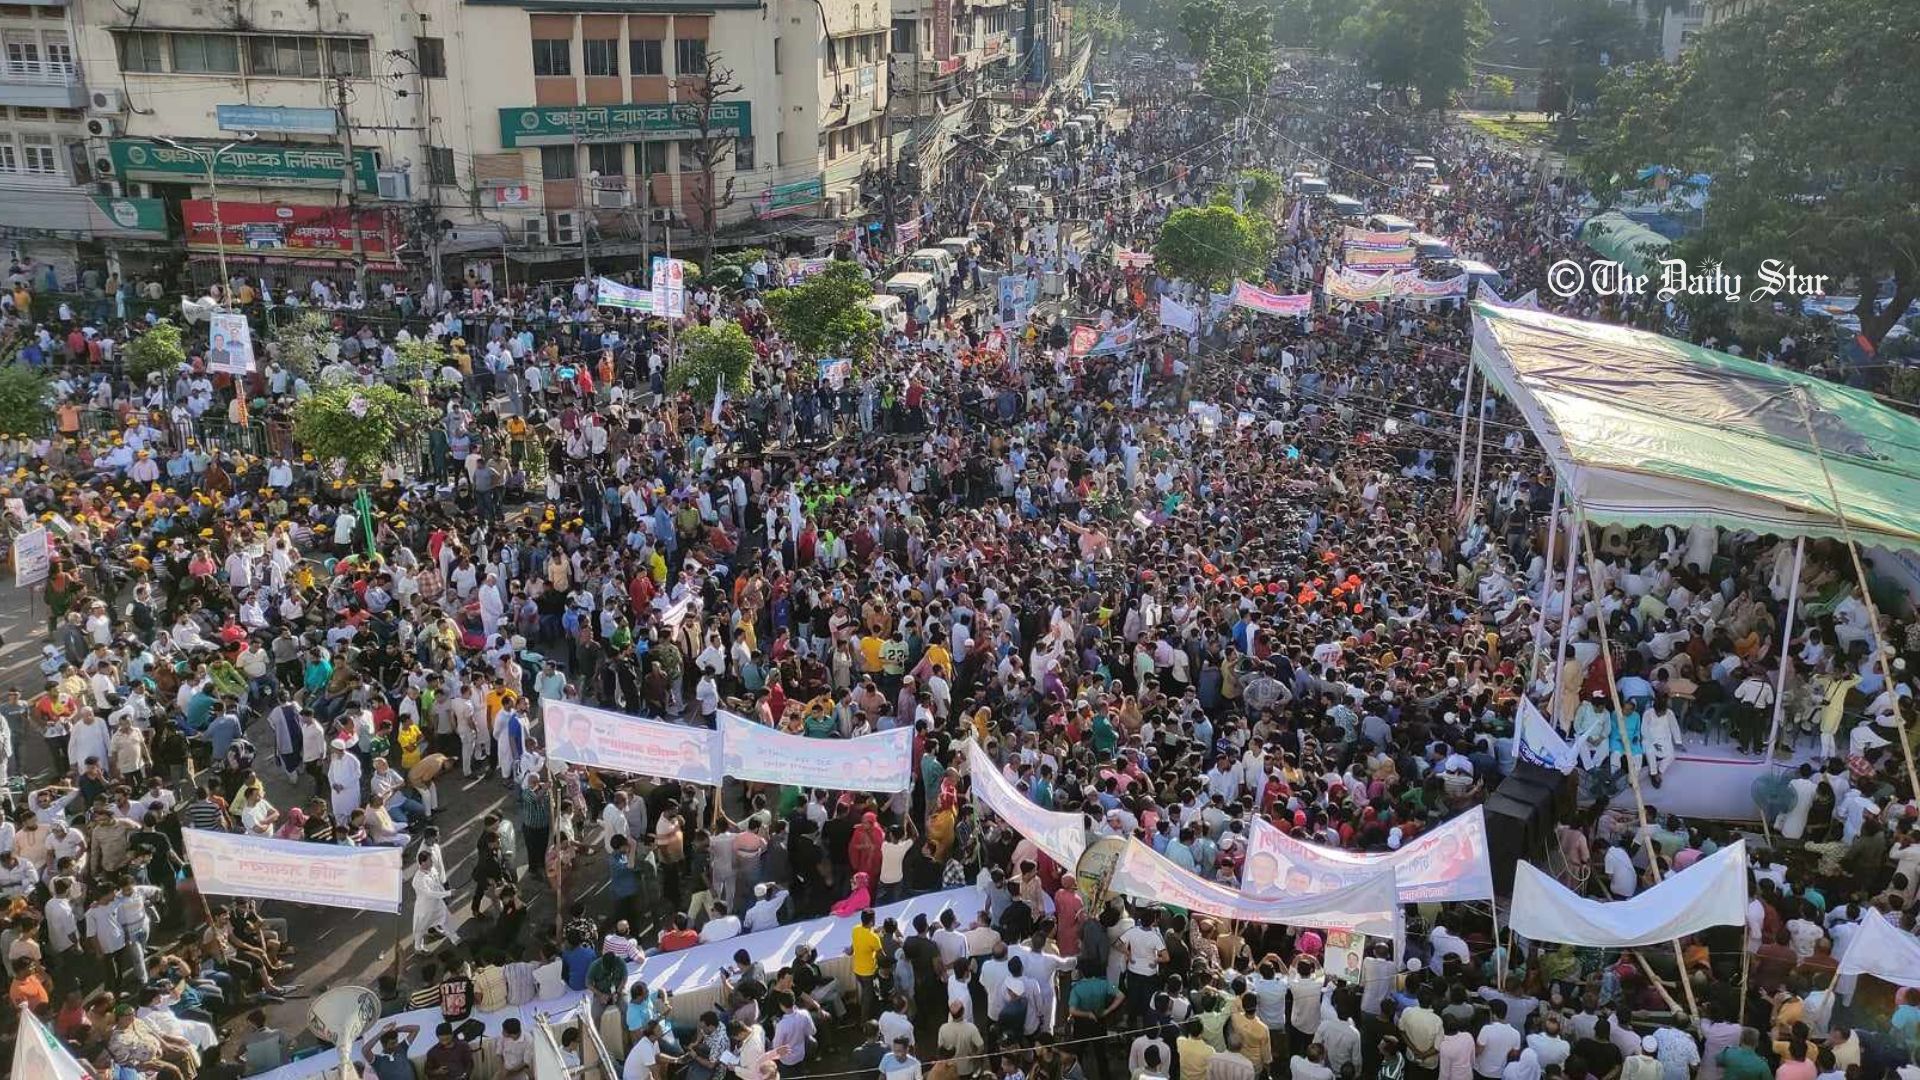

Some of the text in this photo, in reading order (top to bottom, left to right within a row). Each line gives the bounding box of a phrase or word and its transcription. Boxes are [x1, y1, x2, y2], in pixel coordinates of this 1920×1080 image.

[545, 103, 740, 126] অগ্রণী ব্যাংক লিটেড
[151, 147, 215, 165] অগ্রণী
[219, 150, 281, 168] ব্যাংক
